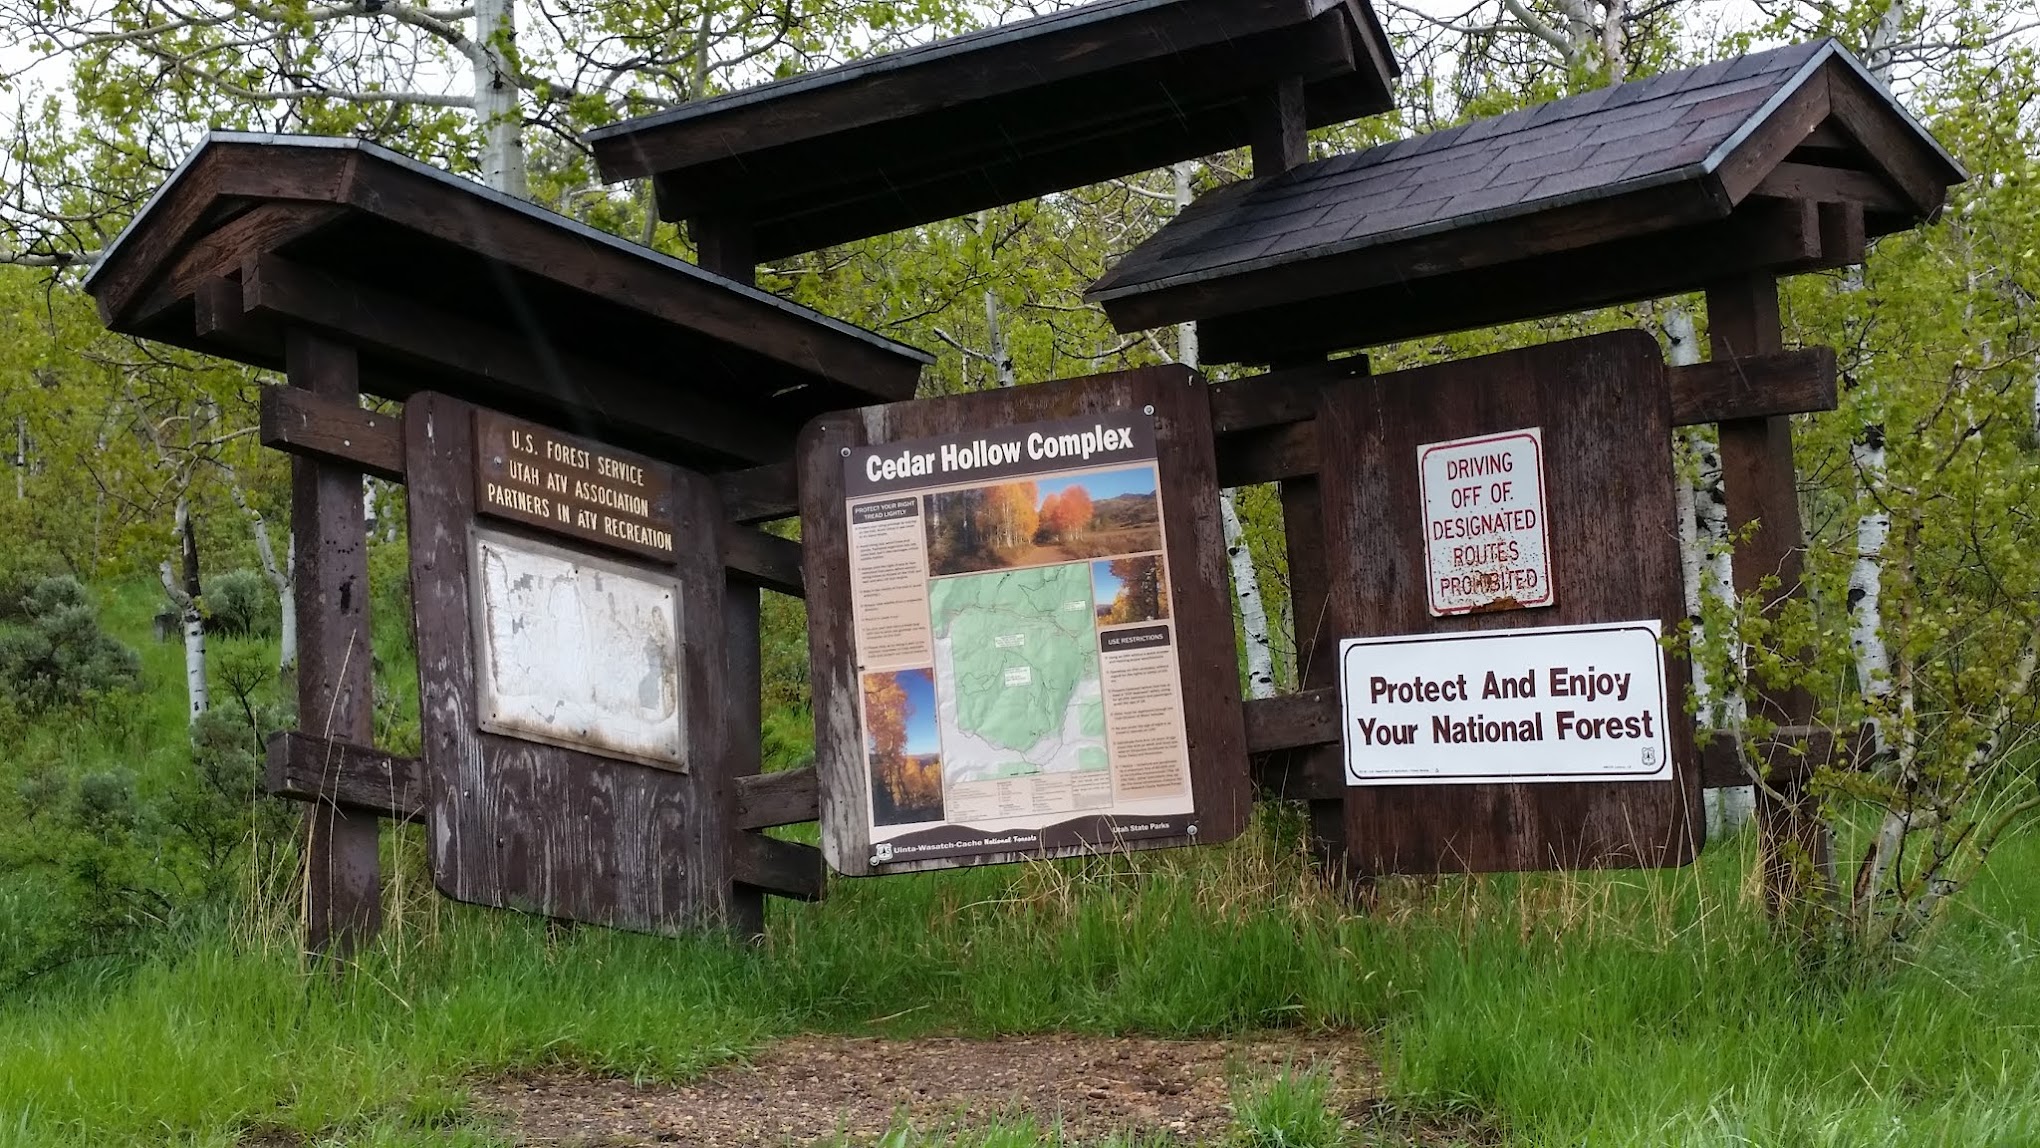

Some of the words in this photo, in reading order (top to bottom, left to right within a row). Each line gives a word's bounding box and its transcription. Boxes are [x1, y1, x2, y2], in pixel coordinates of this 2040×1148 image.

[511, 429, 539, 456] U.S.
[547, 440, 591, 471] FOREST
[598, 456, 645, 487] SERVICE
[866, 451, 936, 483] Cedar
[940, 440, 1021, 472] Hollow
[1027, 424, 1134, 460] Complex
[1447, 452, 1513, 481] DRIVING
[509, 460, 540, 486] UTAH
[547, 472, 568, 494] ATV
[575, 480, 649, 518] ASSOCIATION
[1451, 486, 1482, 509] OFF
[1490, 481, 1513, 503] OF
[487, 483, 550, 518] PARTNERS
[558, 503, 570, 524] IN
[578, 508, 598, 531] ATV
[604, 516, 673, 552] RECREATION
[855, 505, 880, 514] PROTECT
[884, 509, 907, 518] LIGHTLY
[1433, 509, 1537, 541] DESIGNATED
[1453, 541, 1520, 567] ROUTES
[1108, 638, 1120, 646] USE
[1121, 634, 1164, 644] RESTRICTIONS
[1370, 674, 1467, 704] Protect
[1482, 669, 1536, 700] And
[1550, 665, 1632, 703] Enjoy
[1358, 717, 1418, 746] Your
[1432, 712, 1543, 744] National
[1556, 710, 1654, 740] Forest
[1130, 824, 1149, 832] State
[1150, 823, 1170, 831] Parks
[894, 840, 982, 854] Uinta-Wasatch-Cache
[984, 836, 1012, 845] National
